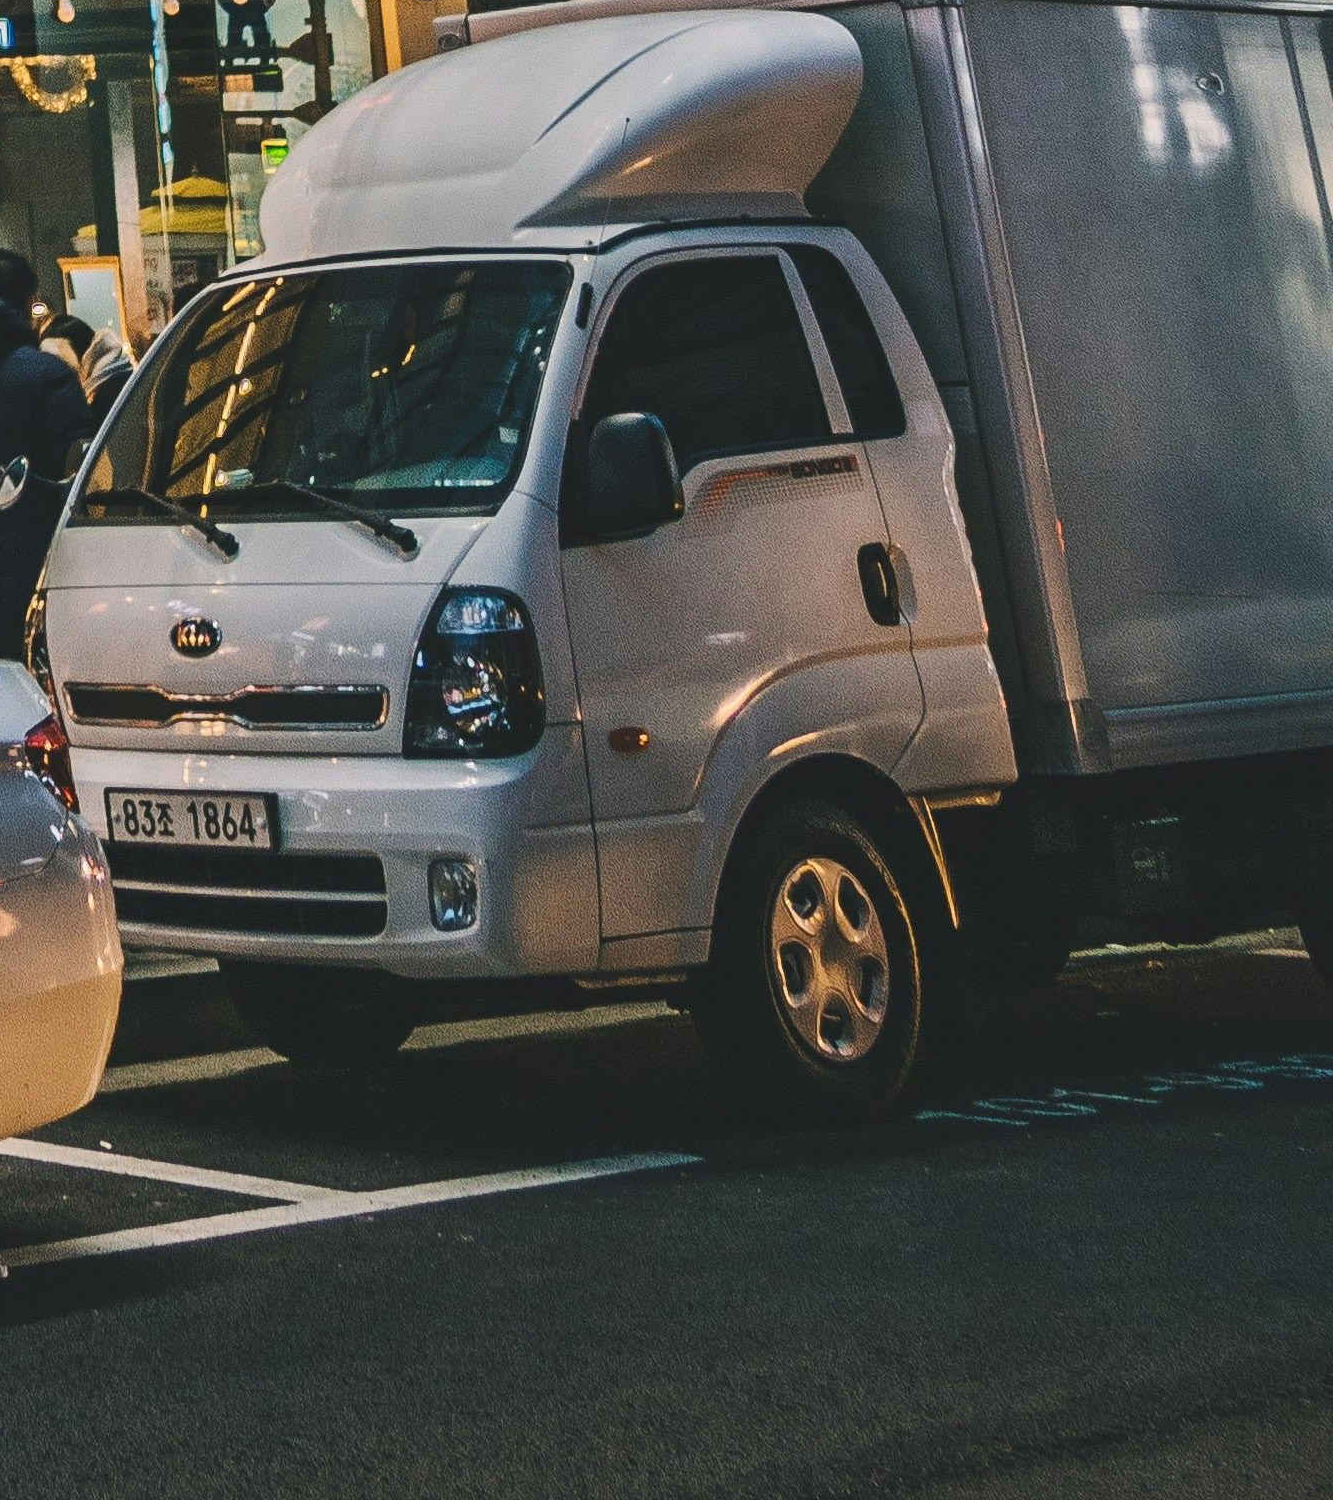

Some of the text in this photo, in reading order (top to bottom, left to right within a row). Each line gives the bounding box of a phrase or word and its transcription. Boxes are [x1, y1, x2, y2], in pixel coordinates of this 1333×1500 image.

[177, 624, 211, 647] KIA
[122, 798, 257, 843] 83조 1864
